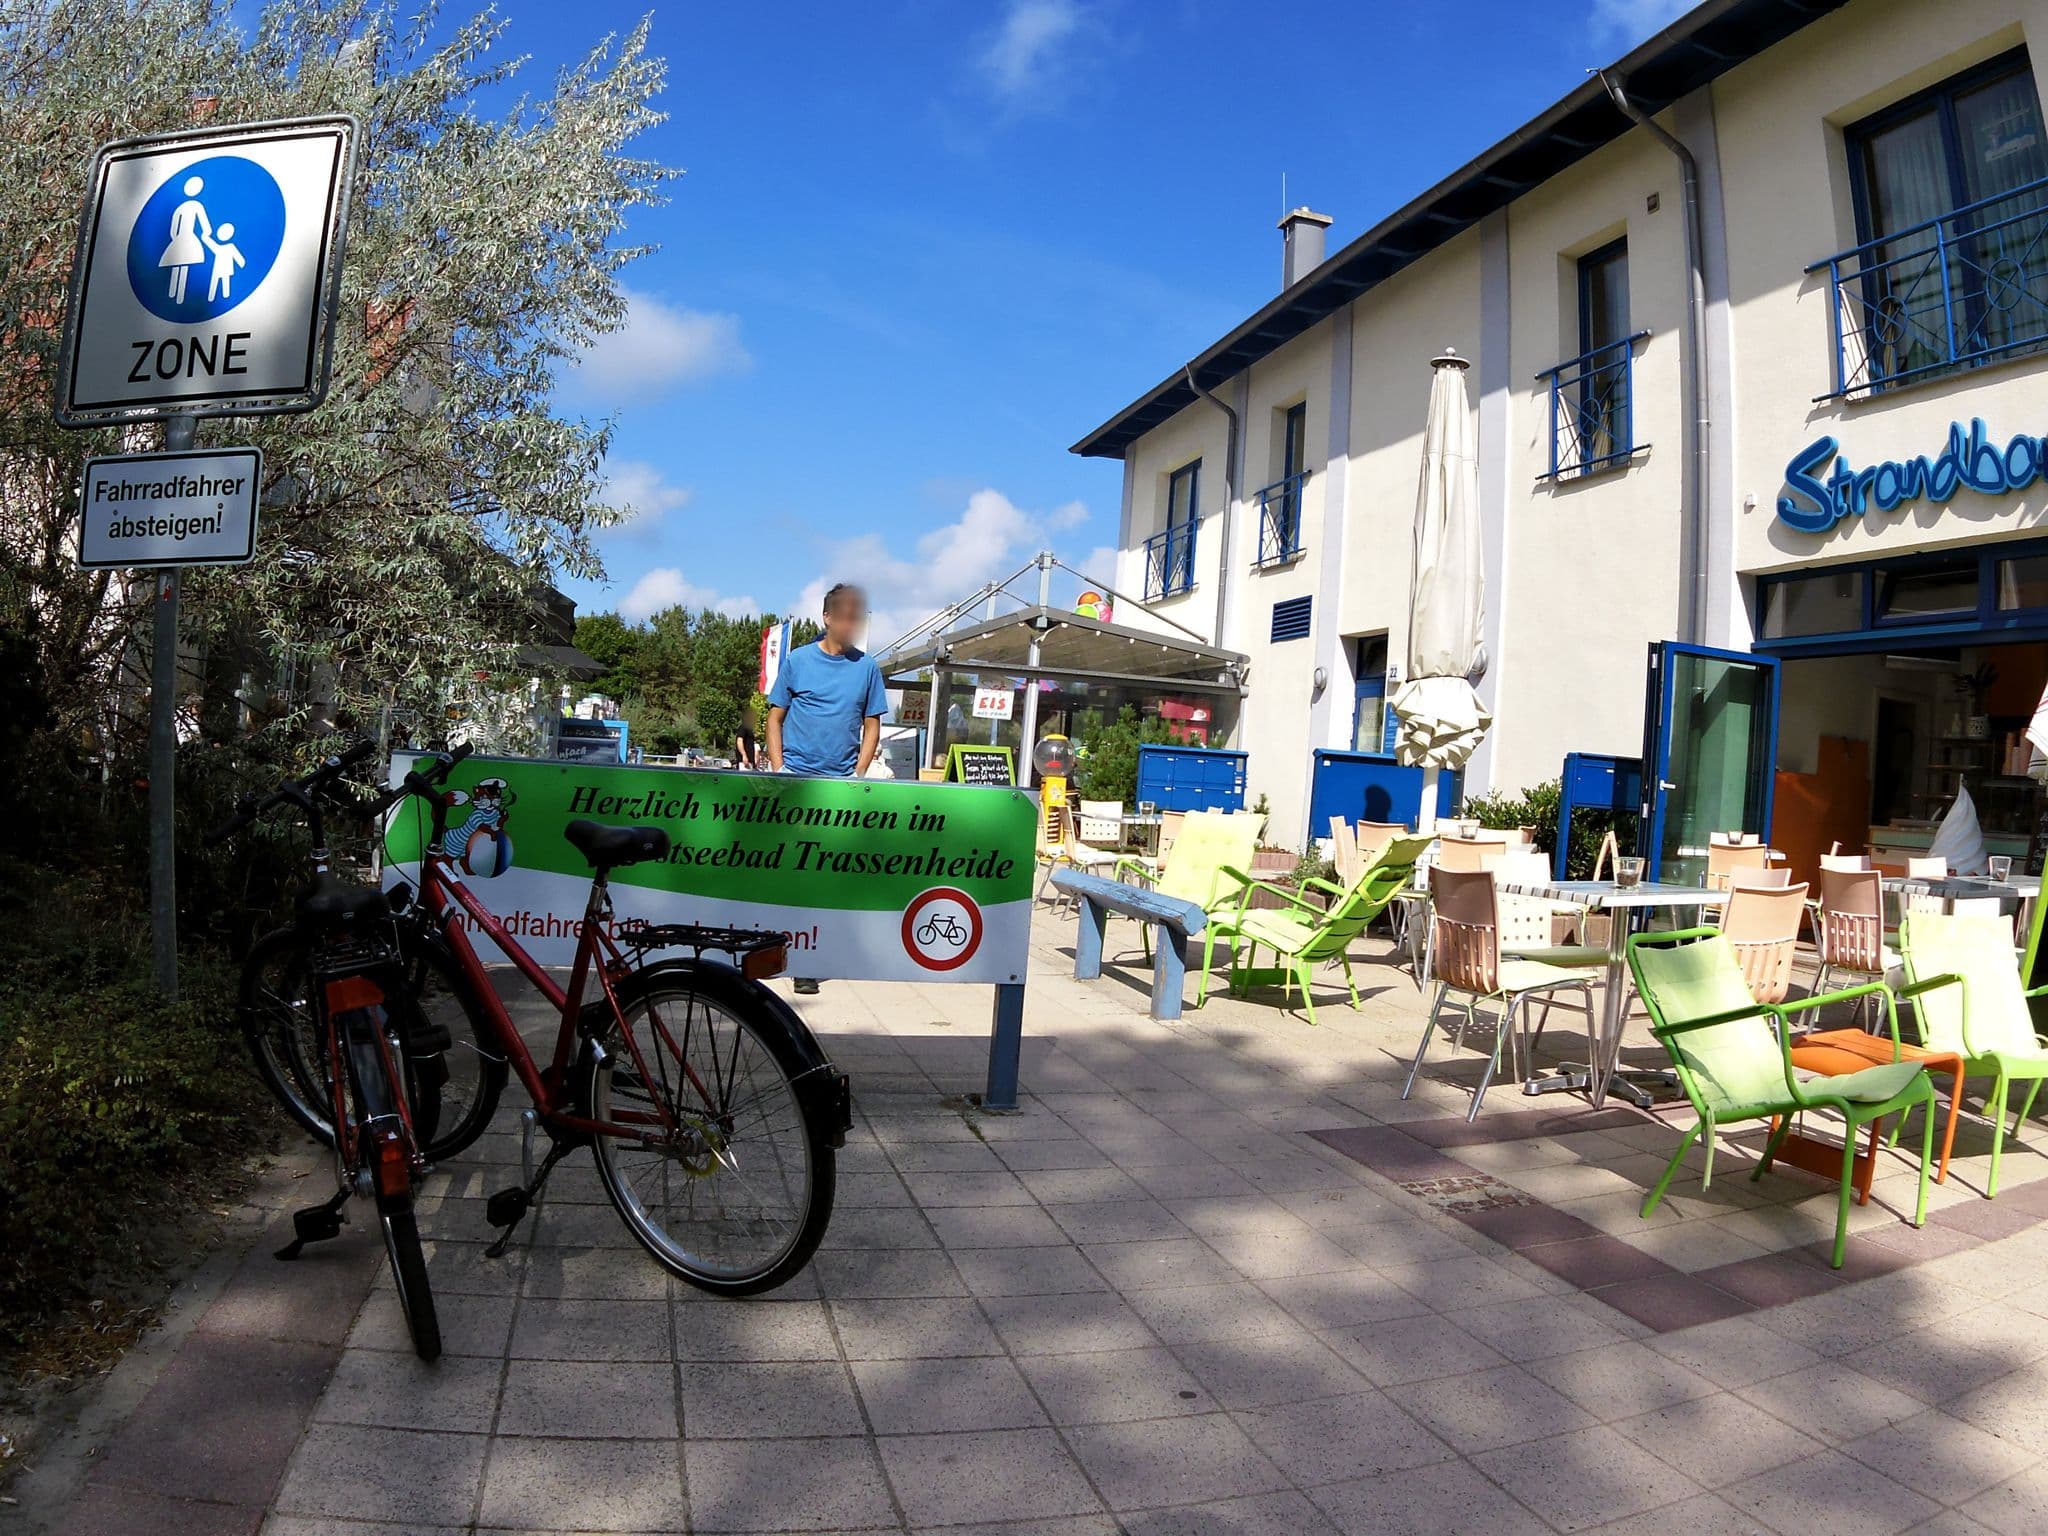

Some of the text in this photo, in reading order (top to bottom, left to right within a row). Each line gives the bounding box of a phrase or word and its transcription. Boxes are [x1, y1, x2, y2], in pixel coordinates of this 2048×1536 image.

[127, 332, 251, 383] ZONE
[94, 475, 245, 502] Fahrradfahrer
[108, 510, 223, 540] absteigen!
[1389, 667, 1398, 678] 22
[902, 710, 926, 720] EIS
[978, 697, 1006, 710] EIS
[567, 785, 946, 832] Herzlich willkommen im
[656, 838, 1015, 880] tseebad Trassenheide
